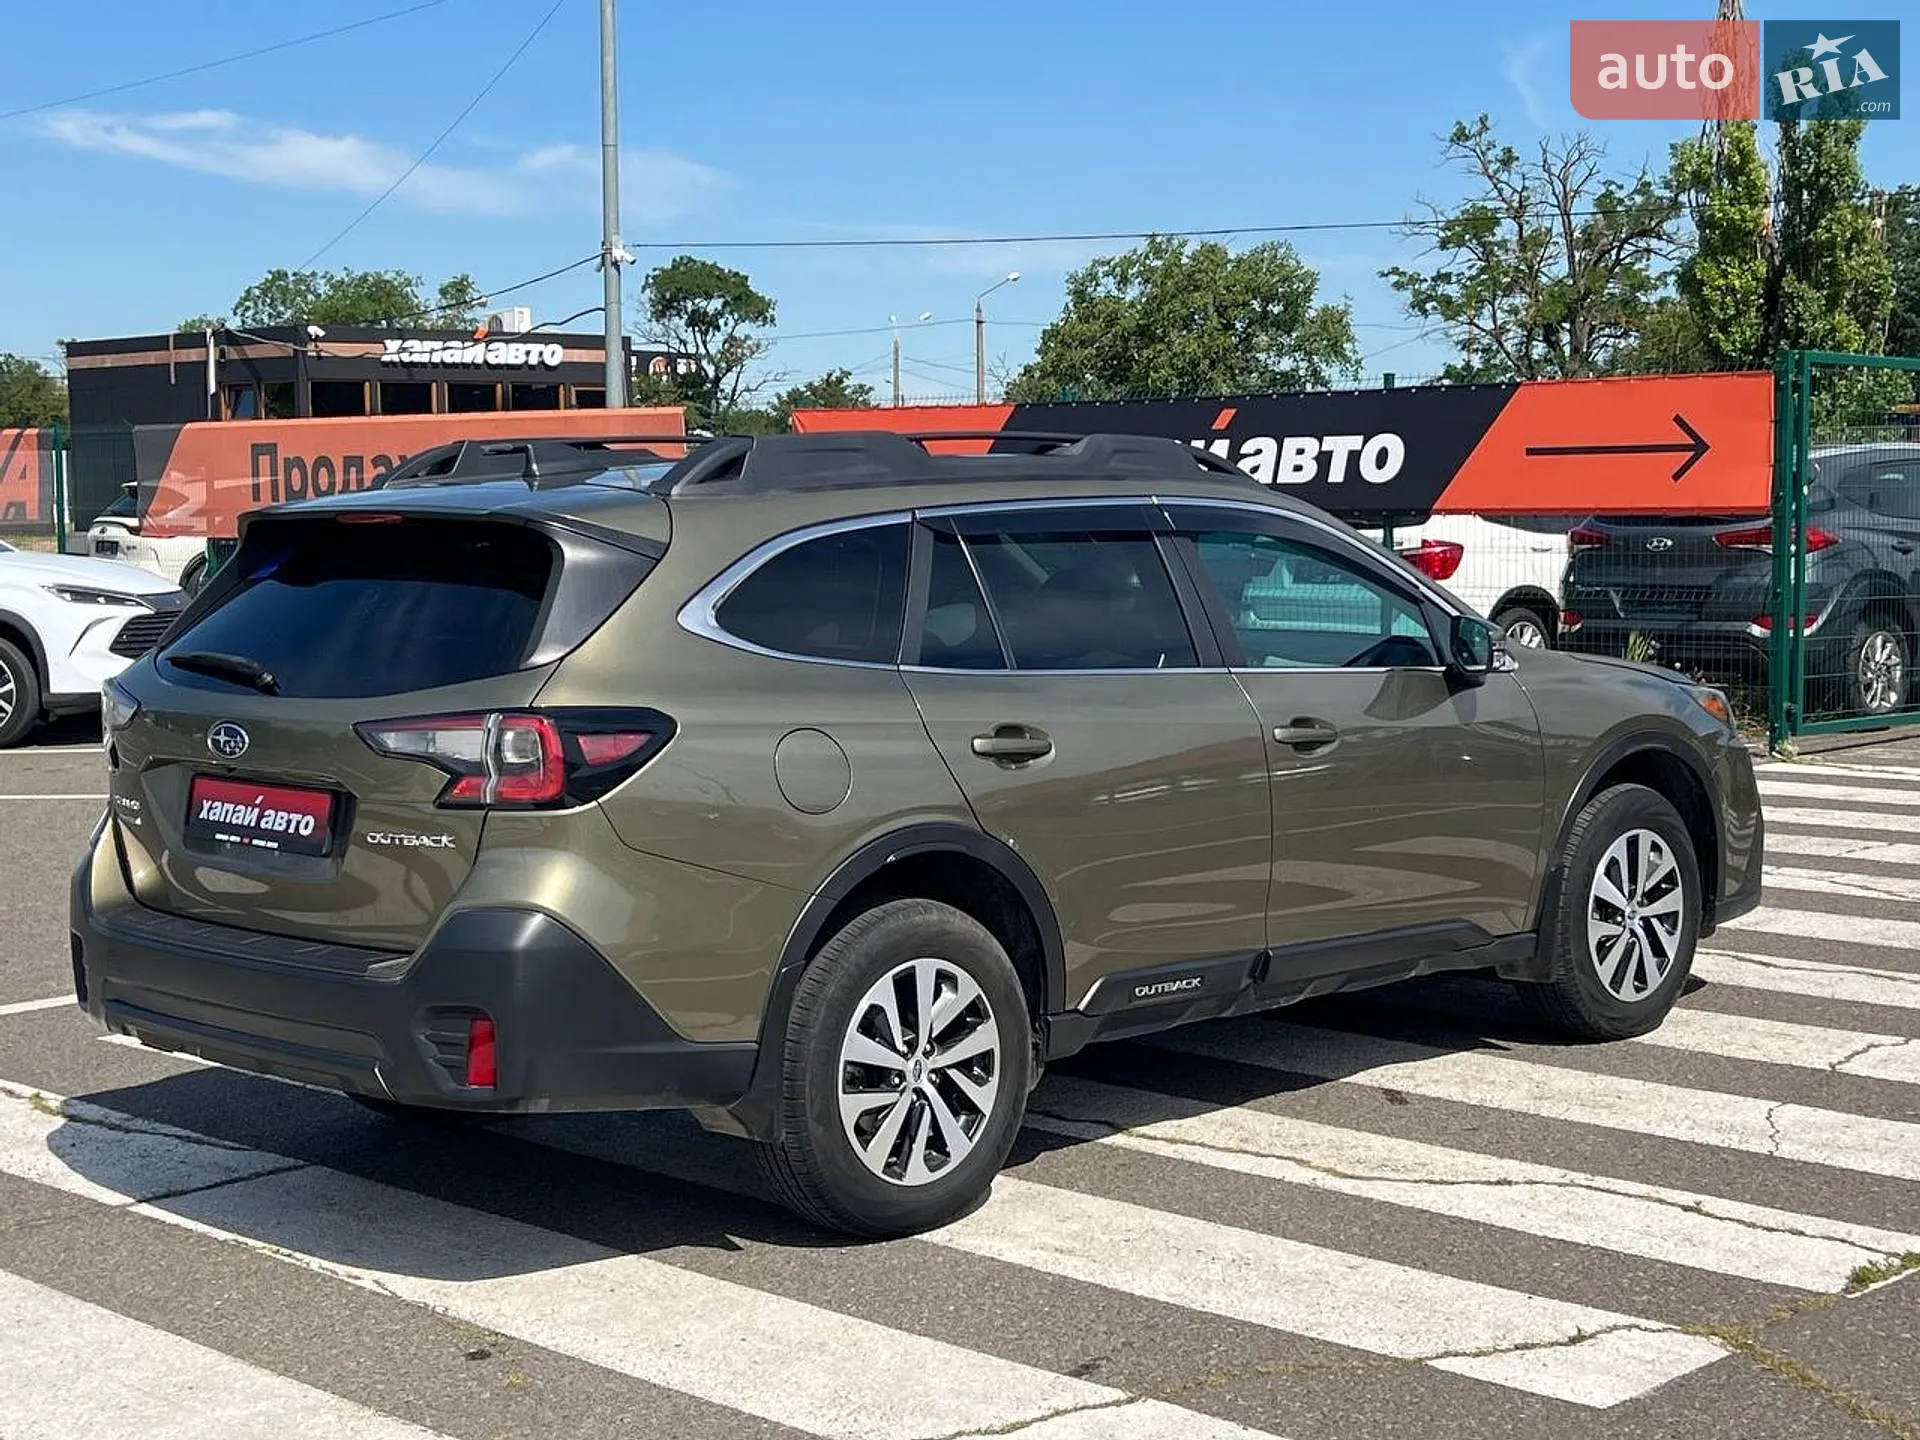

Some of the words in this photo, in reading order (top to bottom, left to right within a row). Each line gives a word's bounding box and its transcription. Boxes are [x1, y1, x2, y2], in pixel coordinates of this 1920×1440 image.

[250, 442, 408, 503] Прода
[260, 809, 315, 837] авто
[366, 832, 456, 848] OUTBACK
[1134, 977, 1202, 997] OUTBACK
